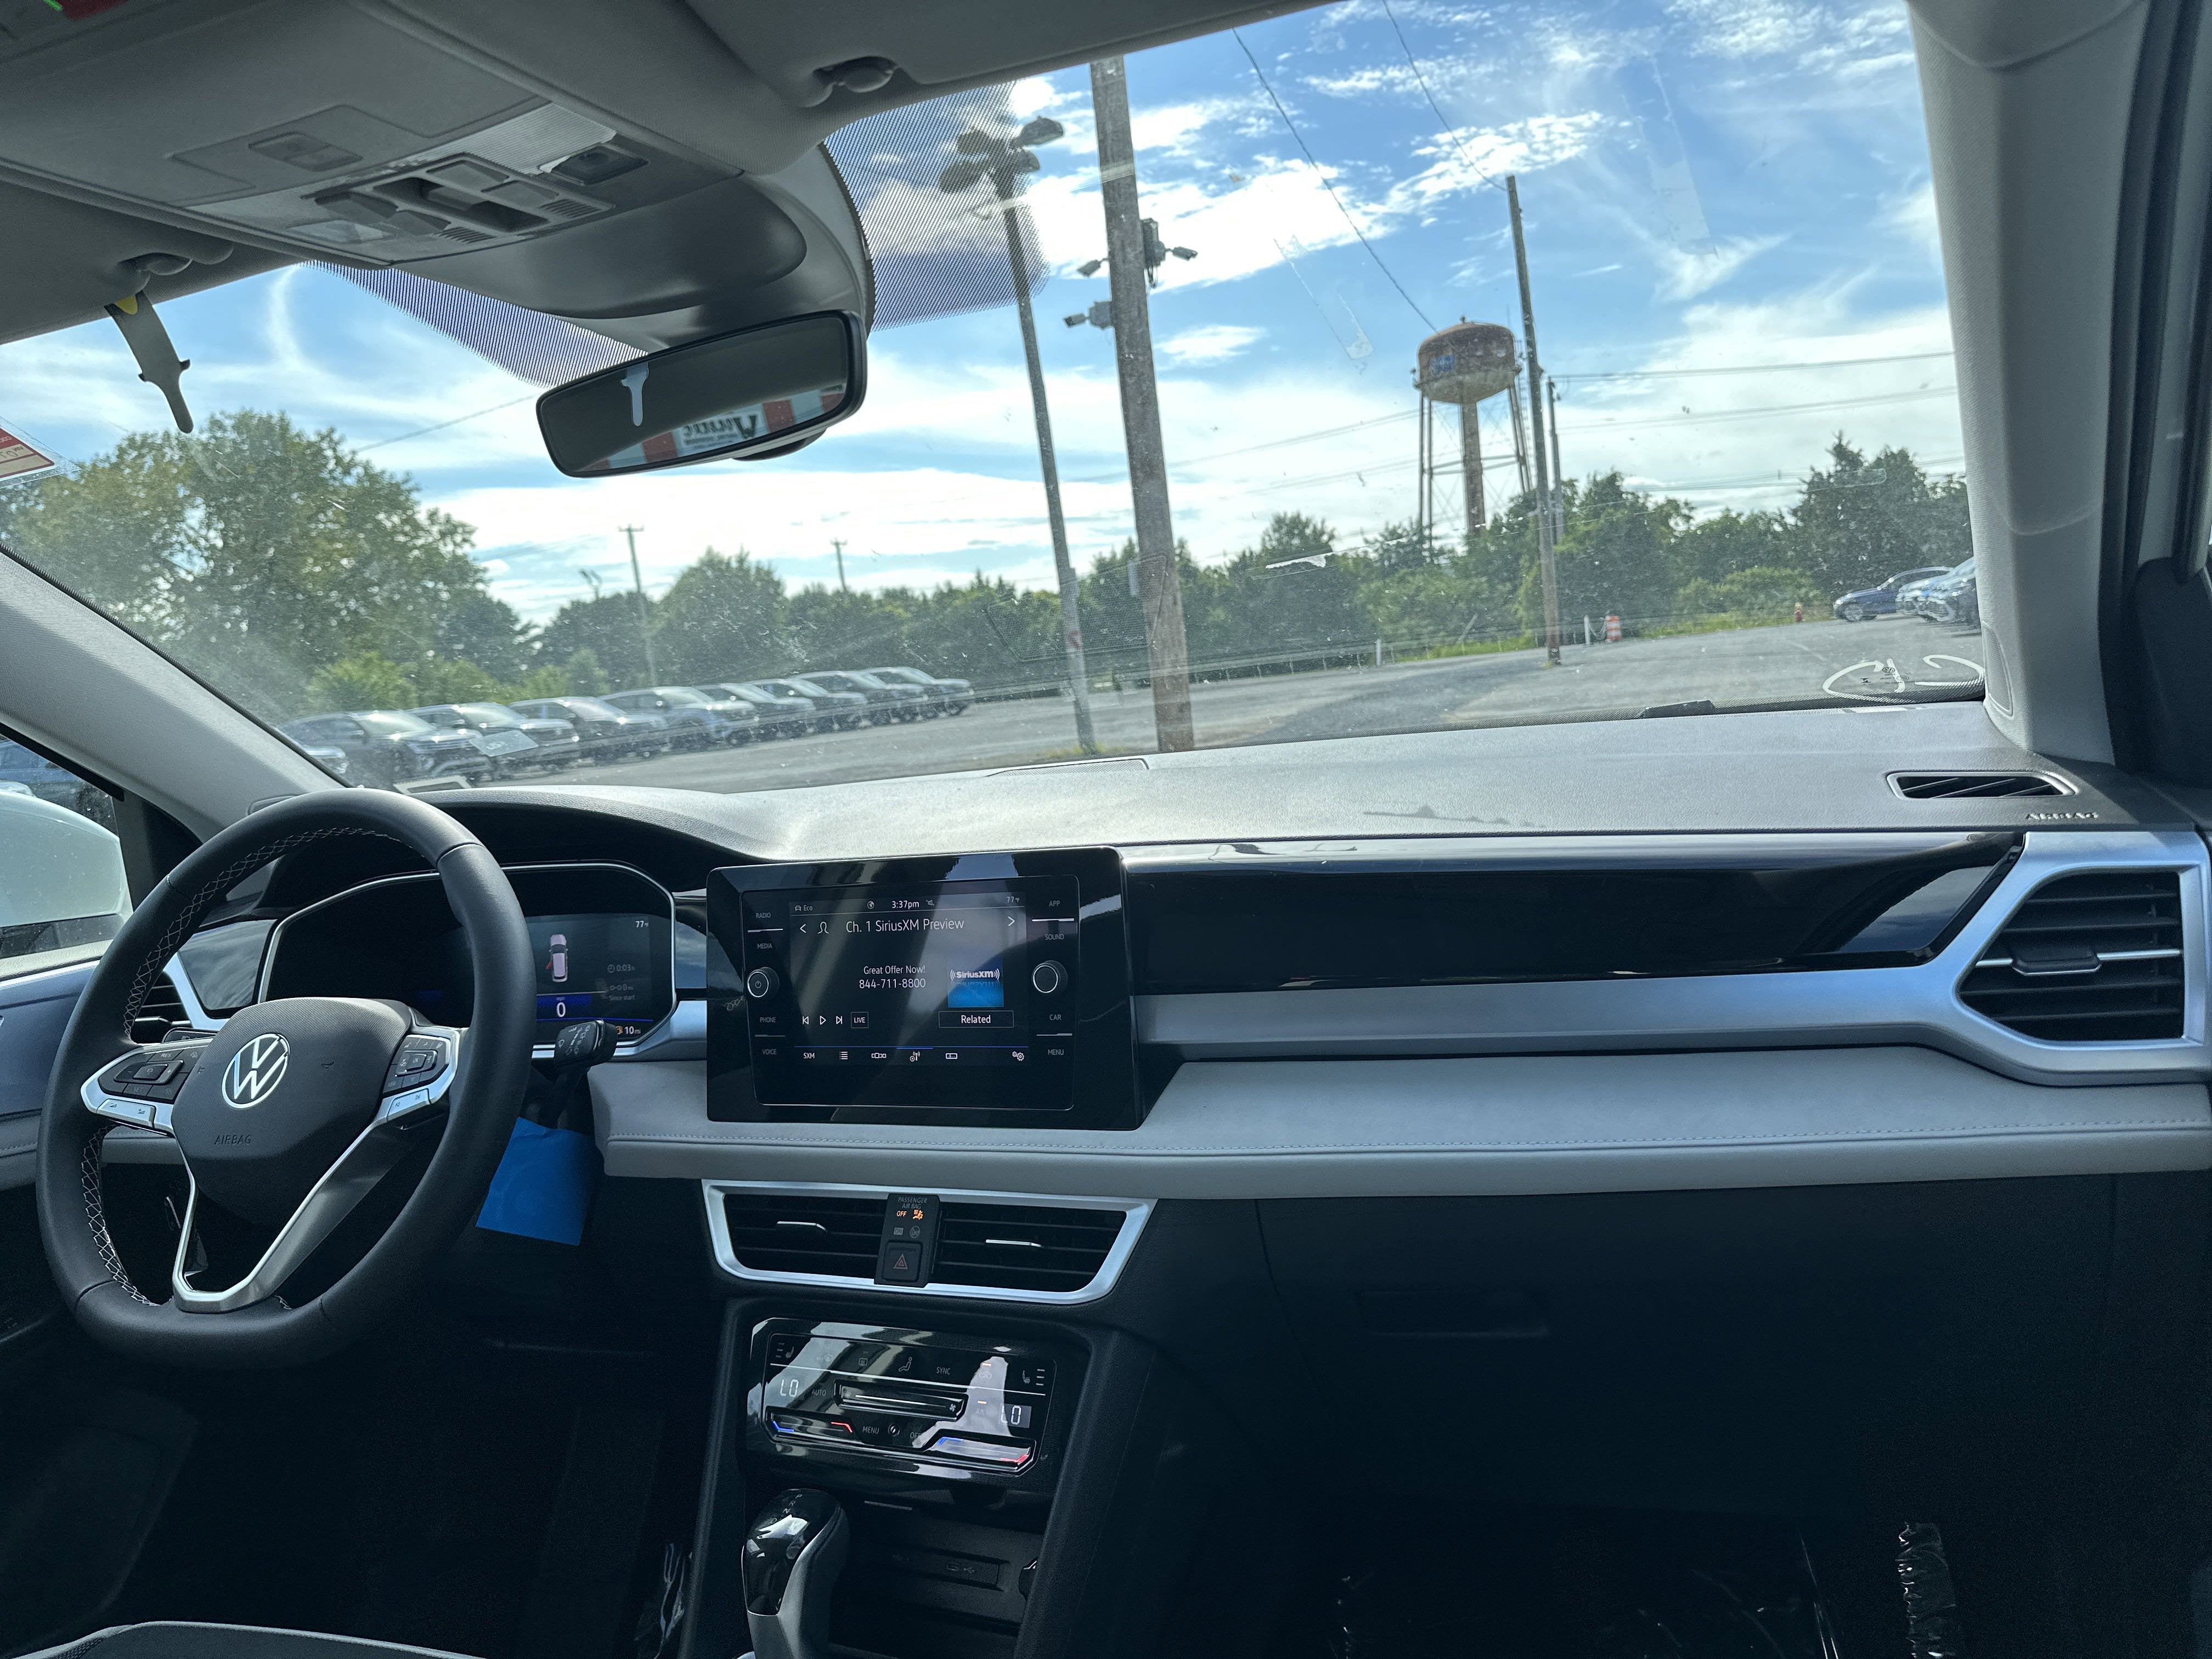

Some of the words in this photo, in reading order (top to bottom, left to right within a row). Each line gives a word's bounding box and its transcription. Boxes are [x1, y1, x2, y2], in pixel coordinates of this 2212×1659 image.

[891, 900, 920, 910] 3:37pm
[846, 921, 862, 933] Ch.
[866, 921, 871, 932] 1
[876, 919, 919, 932] SiriusXM
[923, 918, 964, 930] Preview
[864, 966, 883, 974] Great
[884, 965, 903, 974] Offer
[905, 965, 926, 974] Now!
[859, 978, 926, 989] 844-711-8800
[556, 1002, 566, 1018] 0
[961, 1014, 992, 1024] Related
[214, 1133, 252, 1146] AIRBAG
[936, 1366, 951, 1376] SYNC
[780, 1379, 800, 1397] LO
[811, 1389, 827, 1397] AUTO
[862, 1425, 879, 1435] MENU
